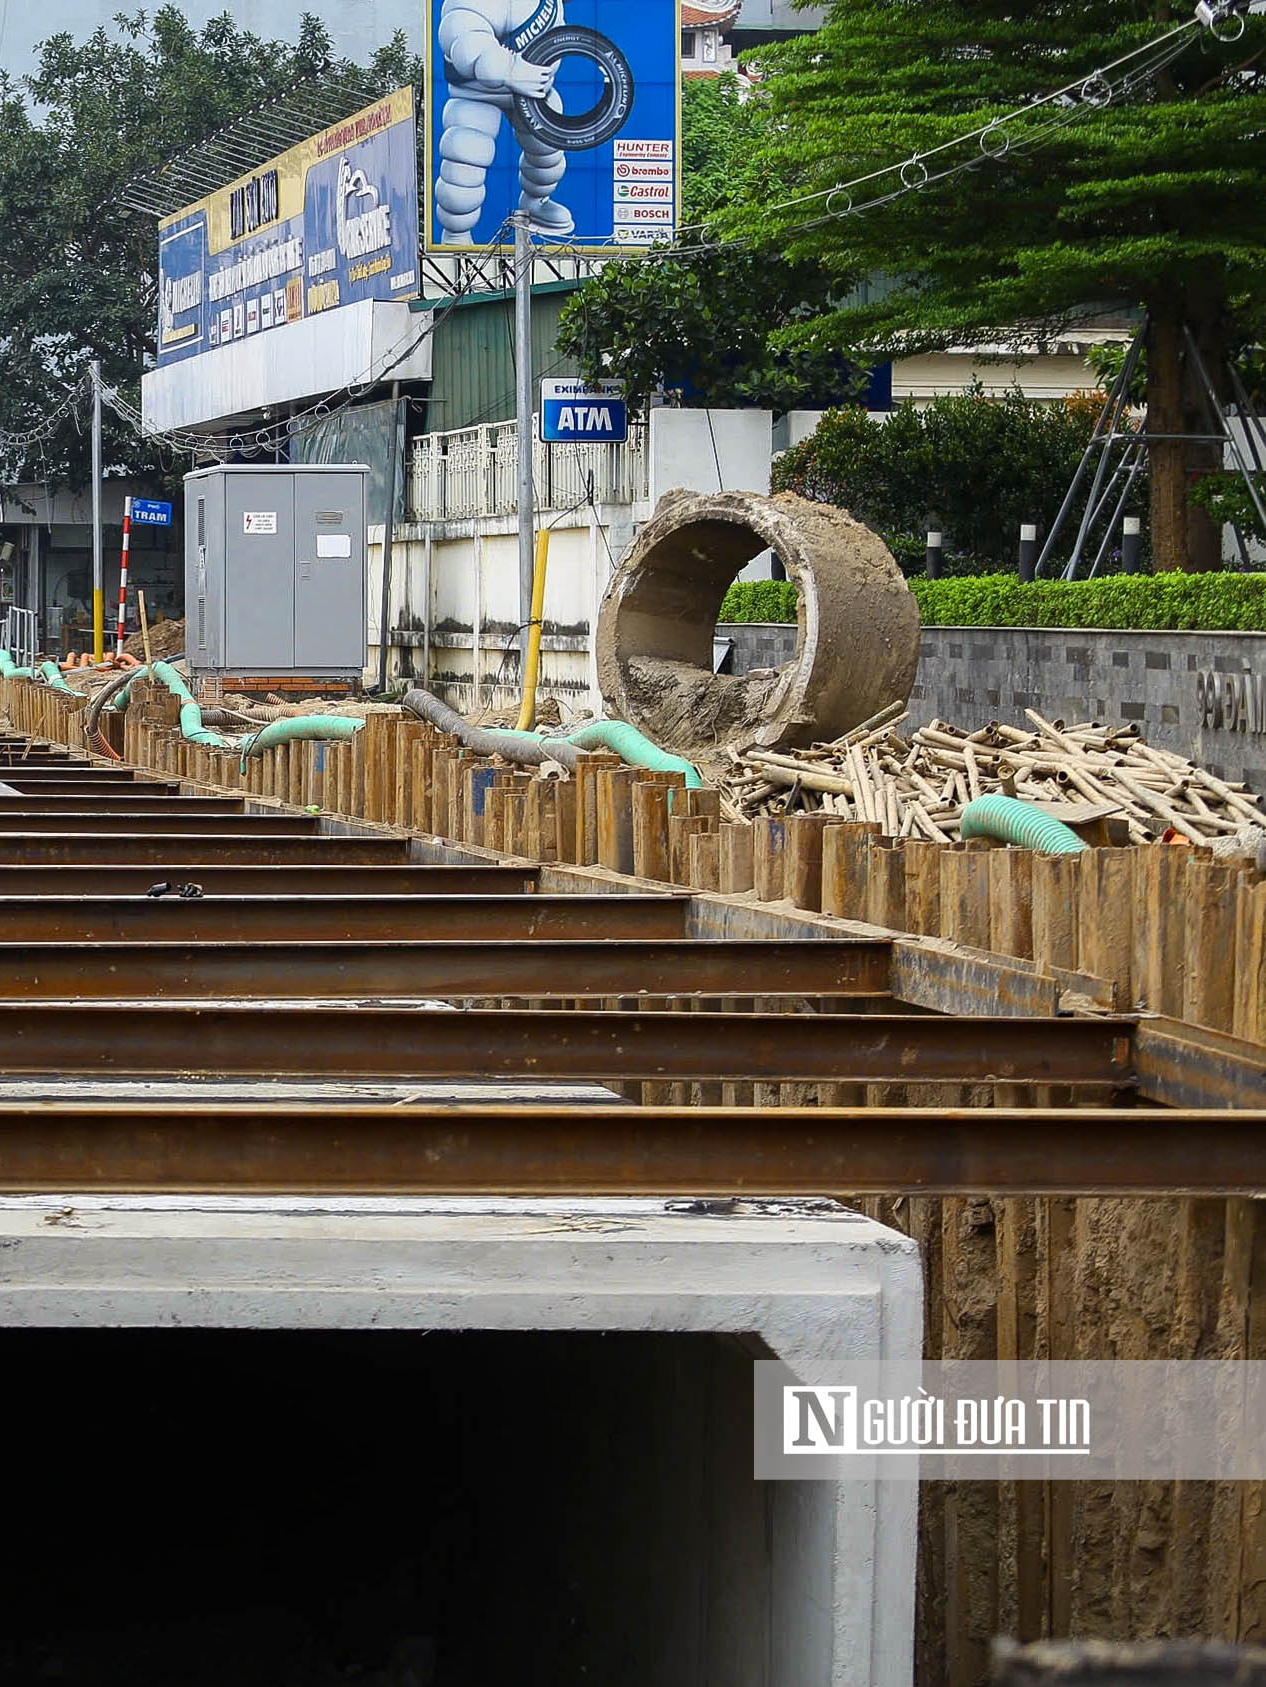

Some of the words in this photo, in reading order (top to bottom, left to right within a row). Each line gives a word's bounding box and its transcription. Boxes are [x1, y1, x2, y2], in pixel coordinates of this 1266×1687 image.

[617, 143, 670, 152] HUNTER
[630, 185, 669, 198] Castrol
[634, 209, 670, 219] BOSCH
[557, 406, 613, 431] ATM
